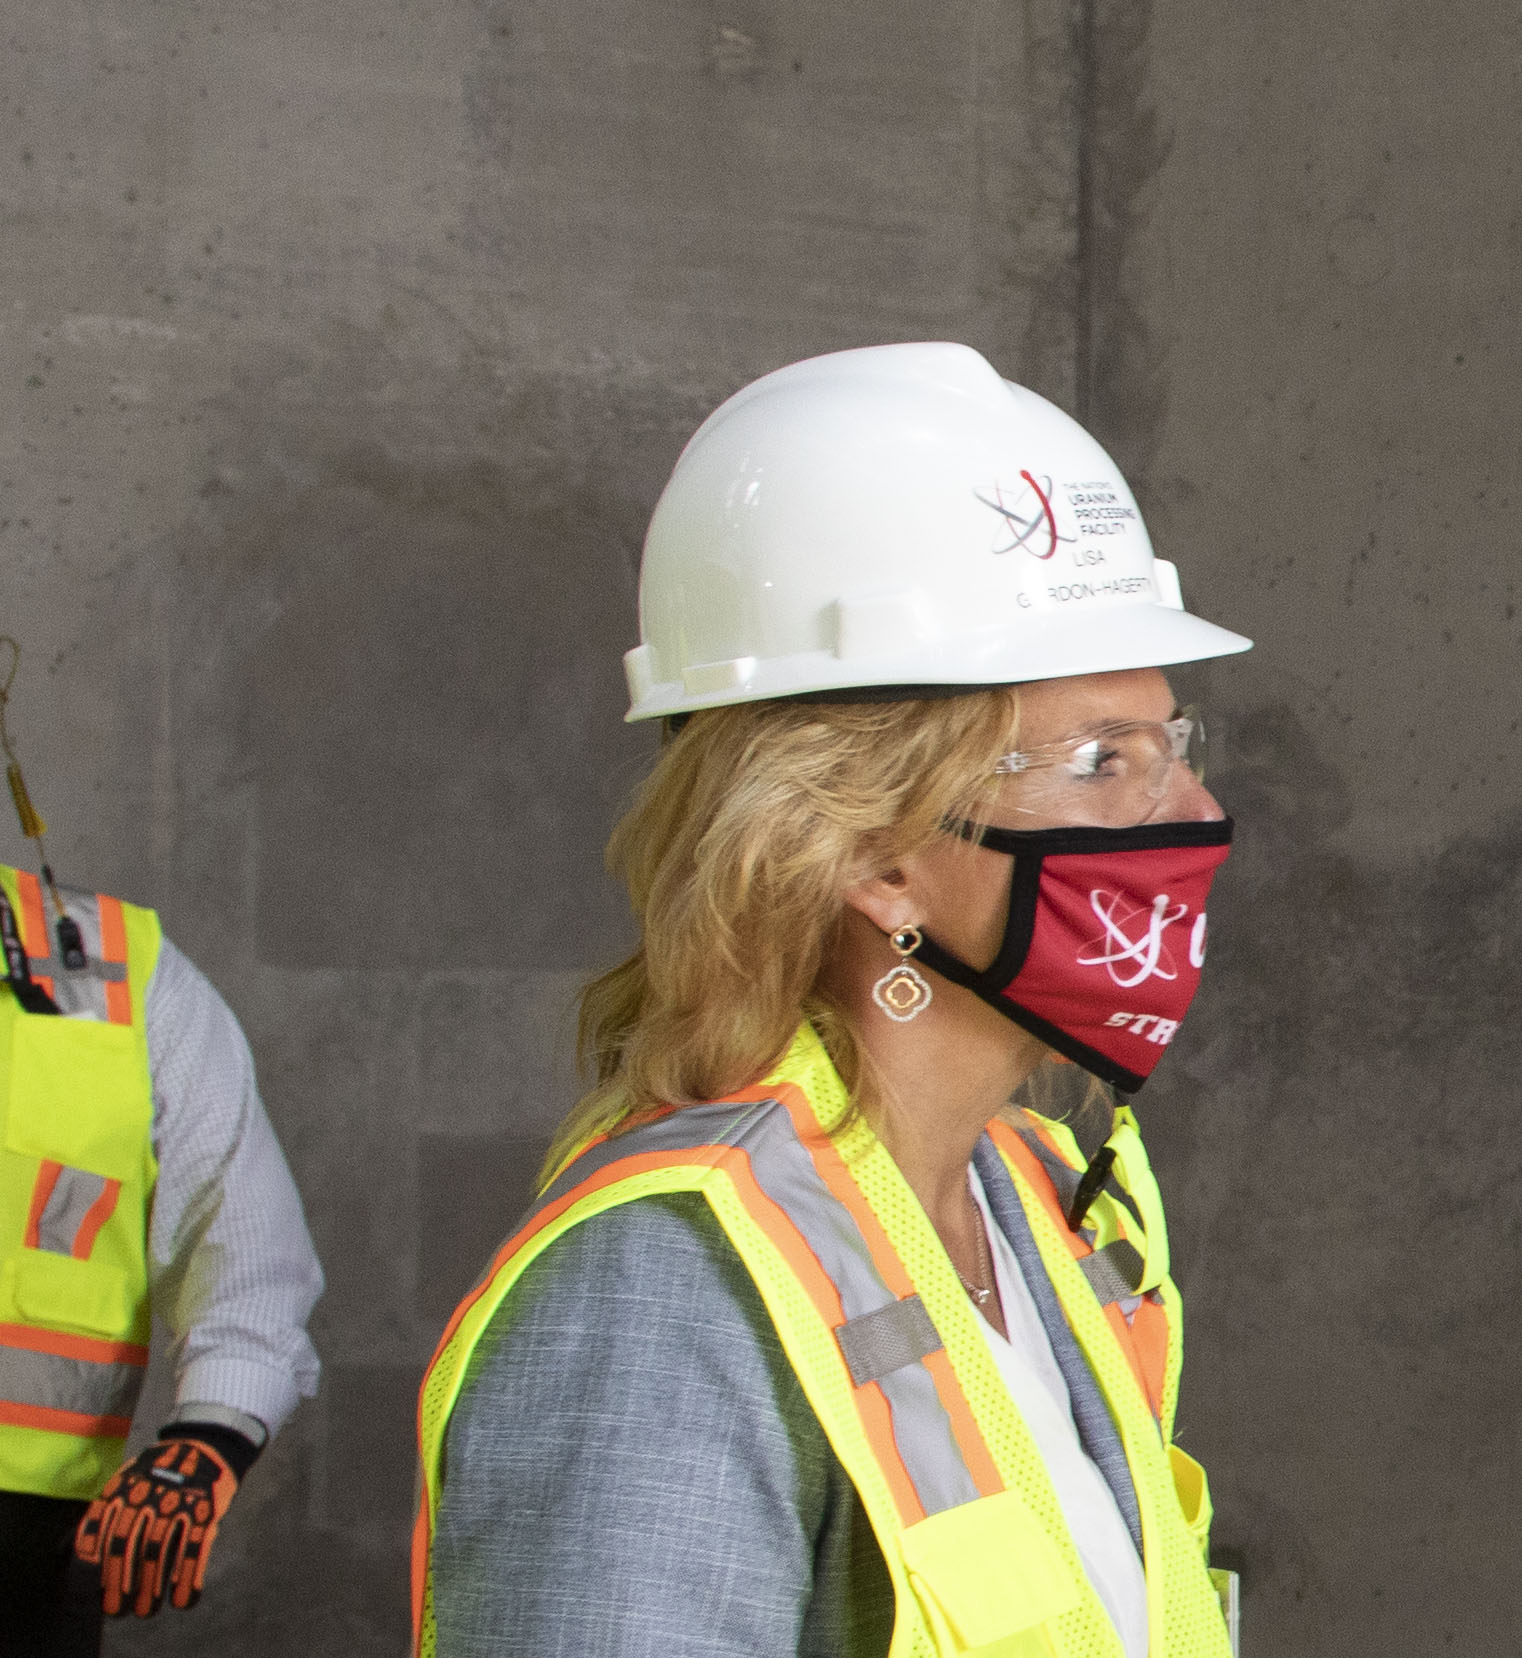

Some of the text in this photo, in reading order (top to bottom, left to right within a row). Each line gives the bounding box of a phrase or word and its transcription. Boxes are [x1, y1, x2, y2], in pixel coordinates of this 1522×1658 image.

[1067, 493, 1118, 506] URANIUM
[1073, 508, 1136, 520] PROCESSING
[1080, 523, 1126, 536] FACILITY
[1072, 549, 1106, 567] LISA
[1016, 577, 1152, 608] GRDON-HAGERTY
